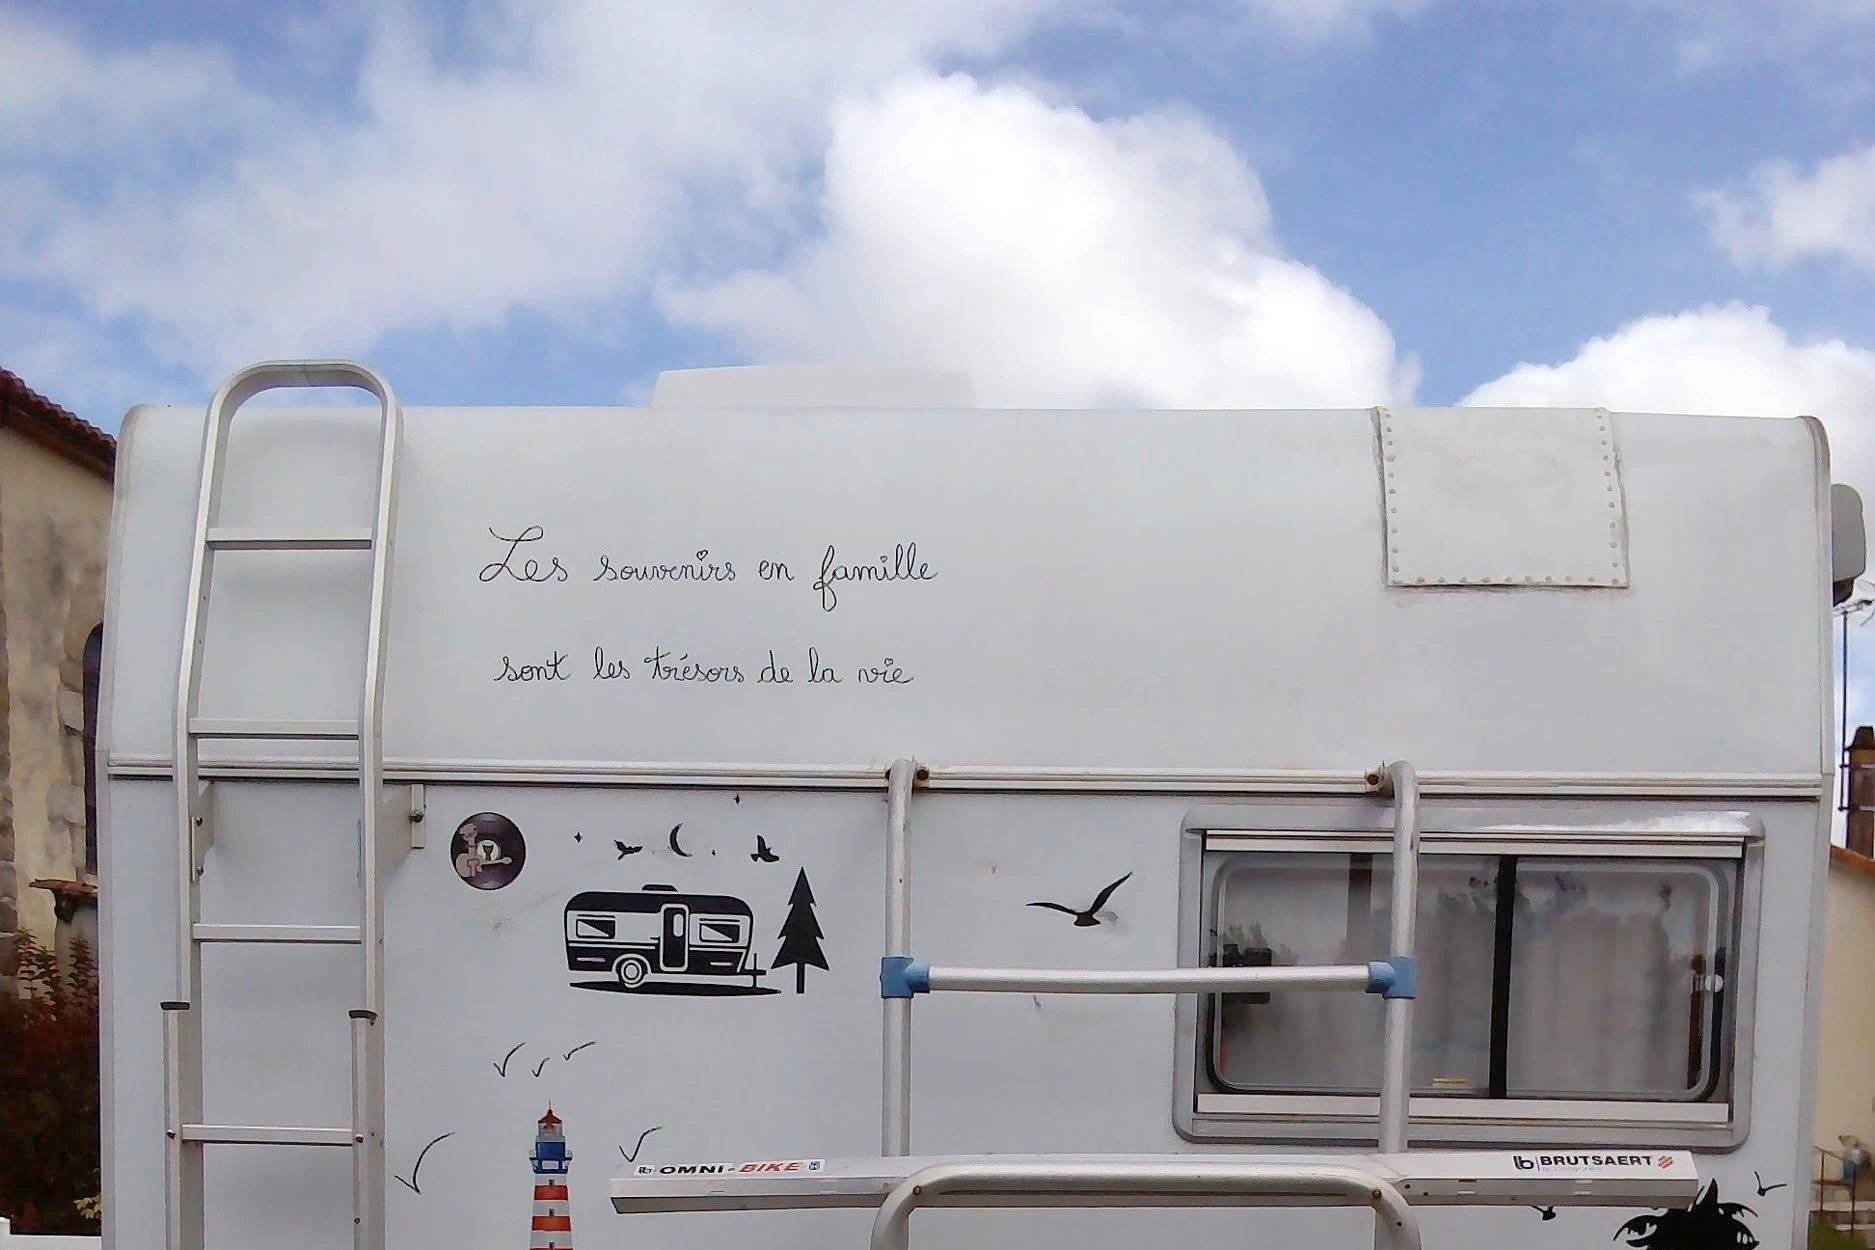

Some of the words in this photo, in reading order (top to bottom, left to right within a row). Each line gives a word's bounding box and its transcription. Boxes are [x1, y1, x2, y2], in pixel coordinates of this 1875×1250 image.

[479, 526, 569, 582] Les
[593, 549, 737, 582] souvenirs
[759, 557, 795, 581] en
[813, 542, 938, 612] famille
[494, 649, 572, 682] sont
[593, 646, 631, 680] les
[644, 646, 745, 683] trésors
[757, 649, 793, 684] de
[808, 646, 842, 683] la
[858, 657, 914, 684] vie
[1541, 1155, 1652, 1166] BRUTSAERT
